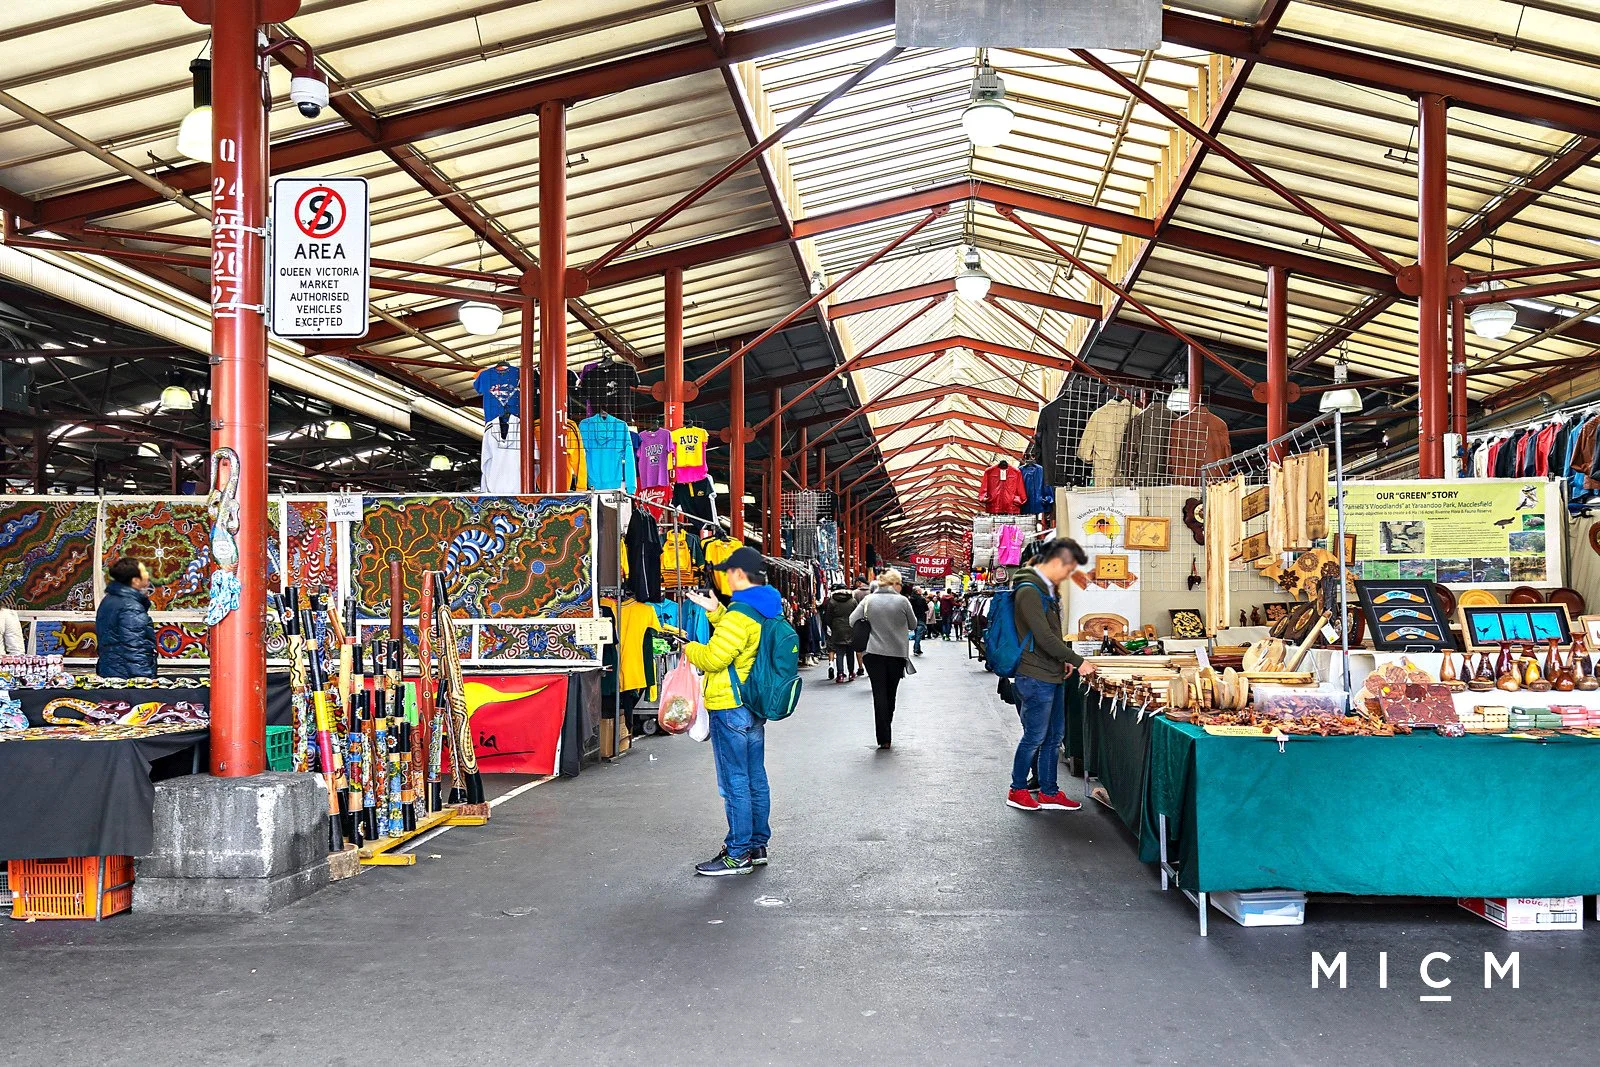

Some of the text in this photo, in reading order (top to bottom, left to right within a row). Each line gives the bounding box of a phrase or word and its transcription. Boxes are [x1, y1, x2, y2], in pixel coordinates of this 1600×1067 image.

[213, 177, 245, 201] 24
[214, 214, 244, 240] 25
[294, 243, 346, 260] AREA
[213, 250, 243, 275] 26
[280, 267, 360, 277] QUEEN VICTORIA
[299, 280, 339, 289] MARKET
[212, 285, 242, 310] 27
[290, 292, 350, 302] AUTHORISED
[297, 305, 342, 314] VEHICLES
[295, 317, 343, 327] EXCEPTED
[680, 435, 699, 445] AUS
[645, 444, 664, 457] AUS
[1376, 490, 1459, 500] OUR "GREEN" STORY
[1458, 500, 1493, 508] Macclesfield
[1077, 506, 1106, 520] Woodcrafts
[915, 557, 929, 565] CAR
[918, 566, 945, 574] COVERS
